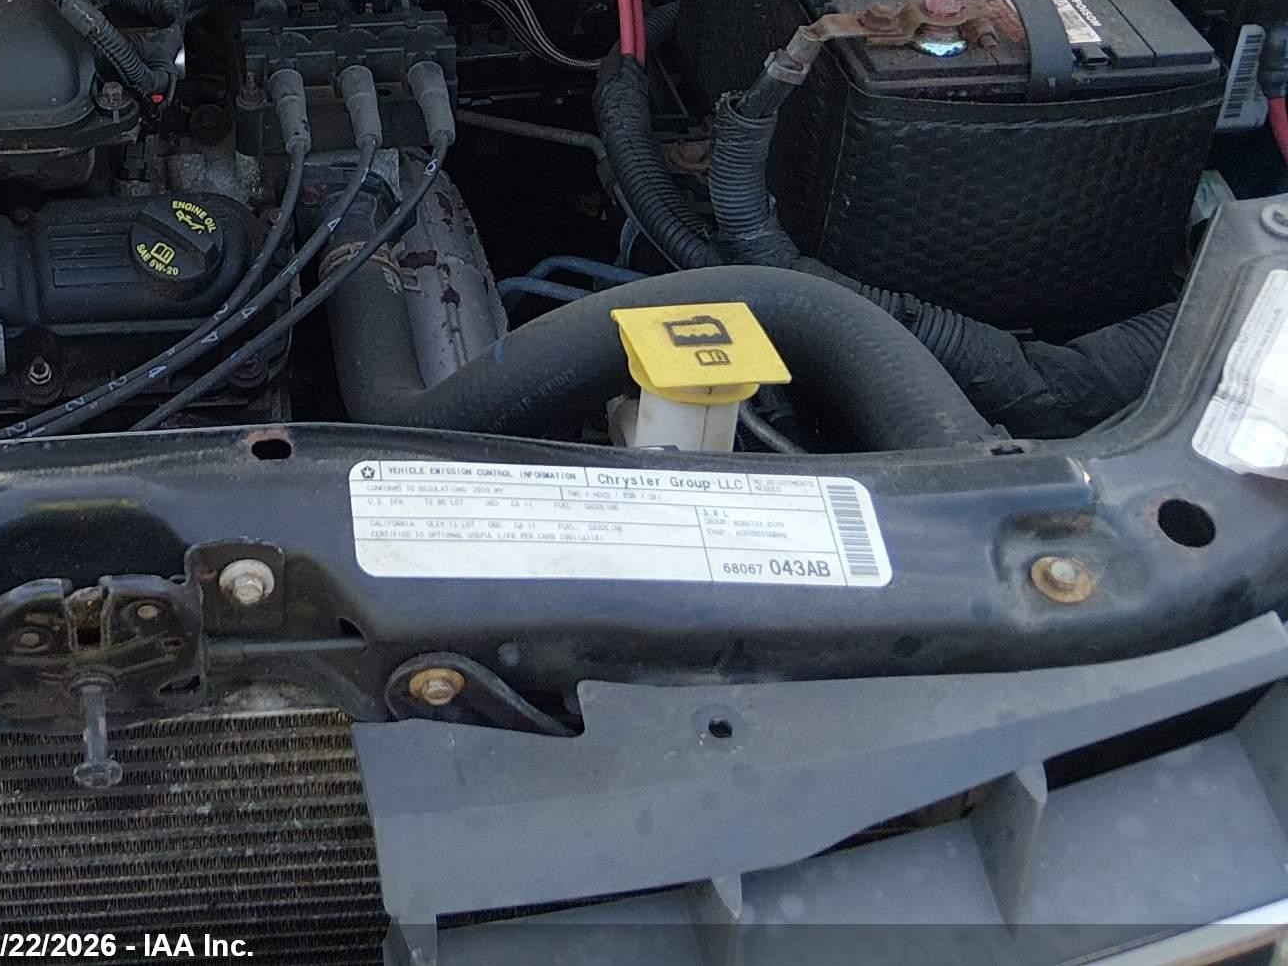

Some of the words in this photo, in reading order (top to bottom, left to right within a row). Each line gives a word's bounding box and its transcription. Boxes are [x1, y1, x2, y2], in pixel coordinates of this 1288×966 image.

[171, 200, 208, 221] ENGINE
[204, 216, 217, 234] OIL
[136, 243, 152, 262] SAE
[149, 260, 179, 276] 5W-20
[388, 466, 424, 475] VEHICLE
[430, 466, 473, 476] EMISSION
[476, 468, 513, 478] CONTROL
[519, 470, 576, 480] INFORMATION
[597, 473, 661, 489] Chrysler
[670, 476, 711, 492] Group
[718, 478, 743, 490] LLC
[723, 562, 763, 575] 68067
[769, 559, 831, 577] 043AB
